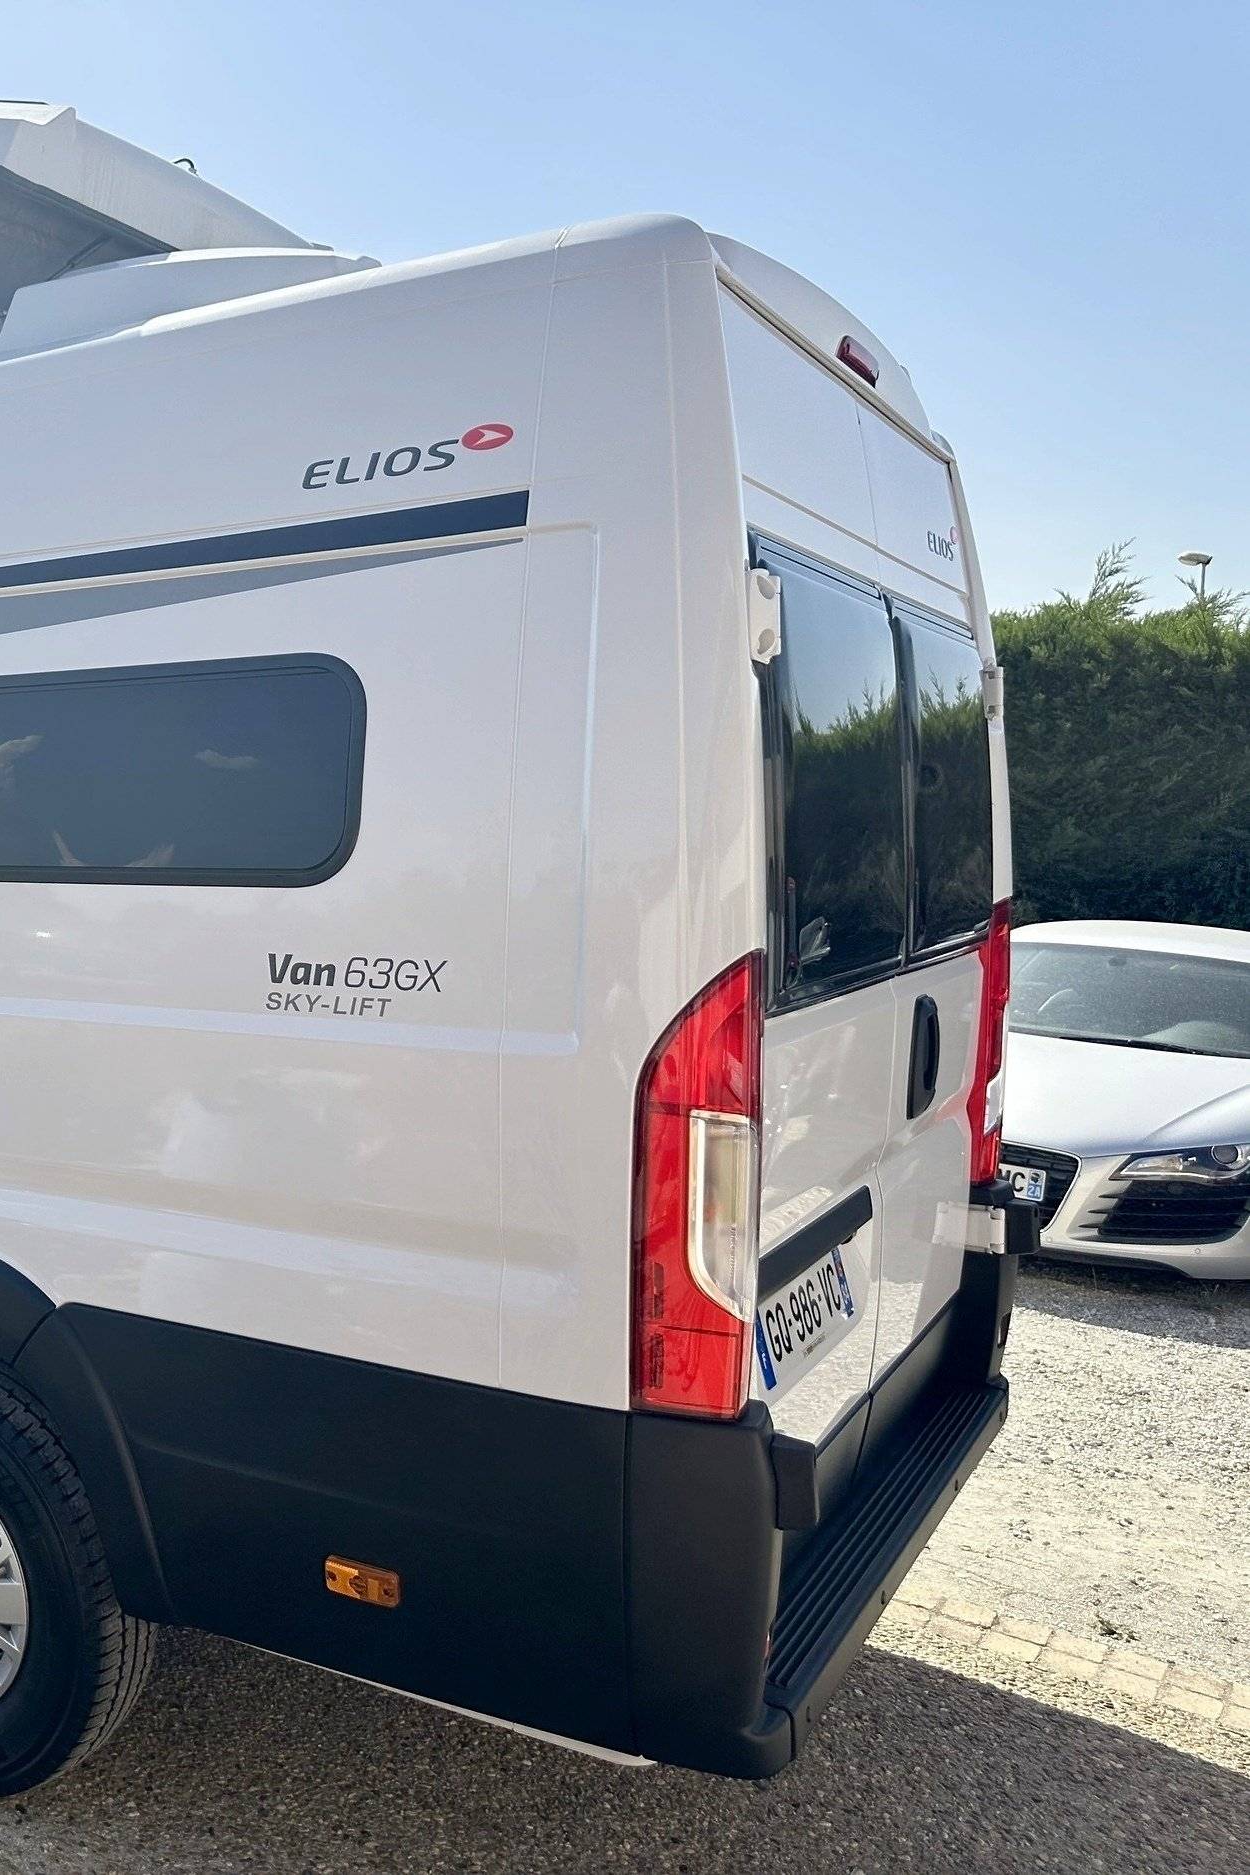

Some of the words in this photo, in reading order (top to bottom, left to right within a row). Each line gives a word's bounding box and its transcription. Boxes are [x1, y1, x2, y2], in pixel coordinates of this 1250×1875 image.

[301, 438, 459, 490] ELIOS
[927, 530, 954, 561] ELIOS
[267, 952, 336, 987] Van
[344, 956, 448, 993] 63GX
[265, 991, 392, 1017] SKY-LIFT
[765, 1263, 842, 1363] GQ-986-VC
